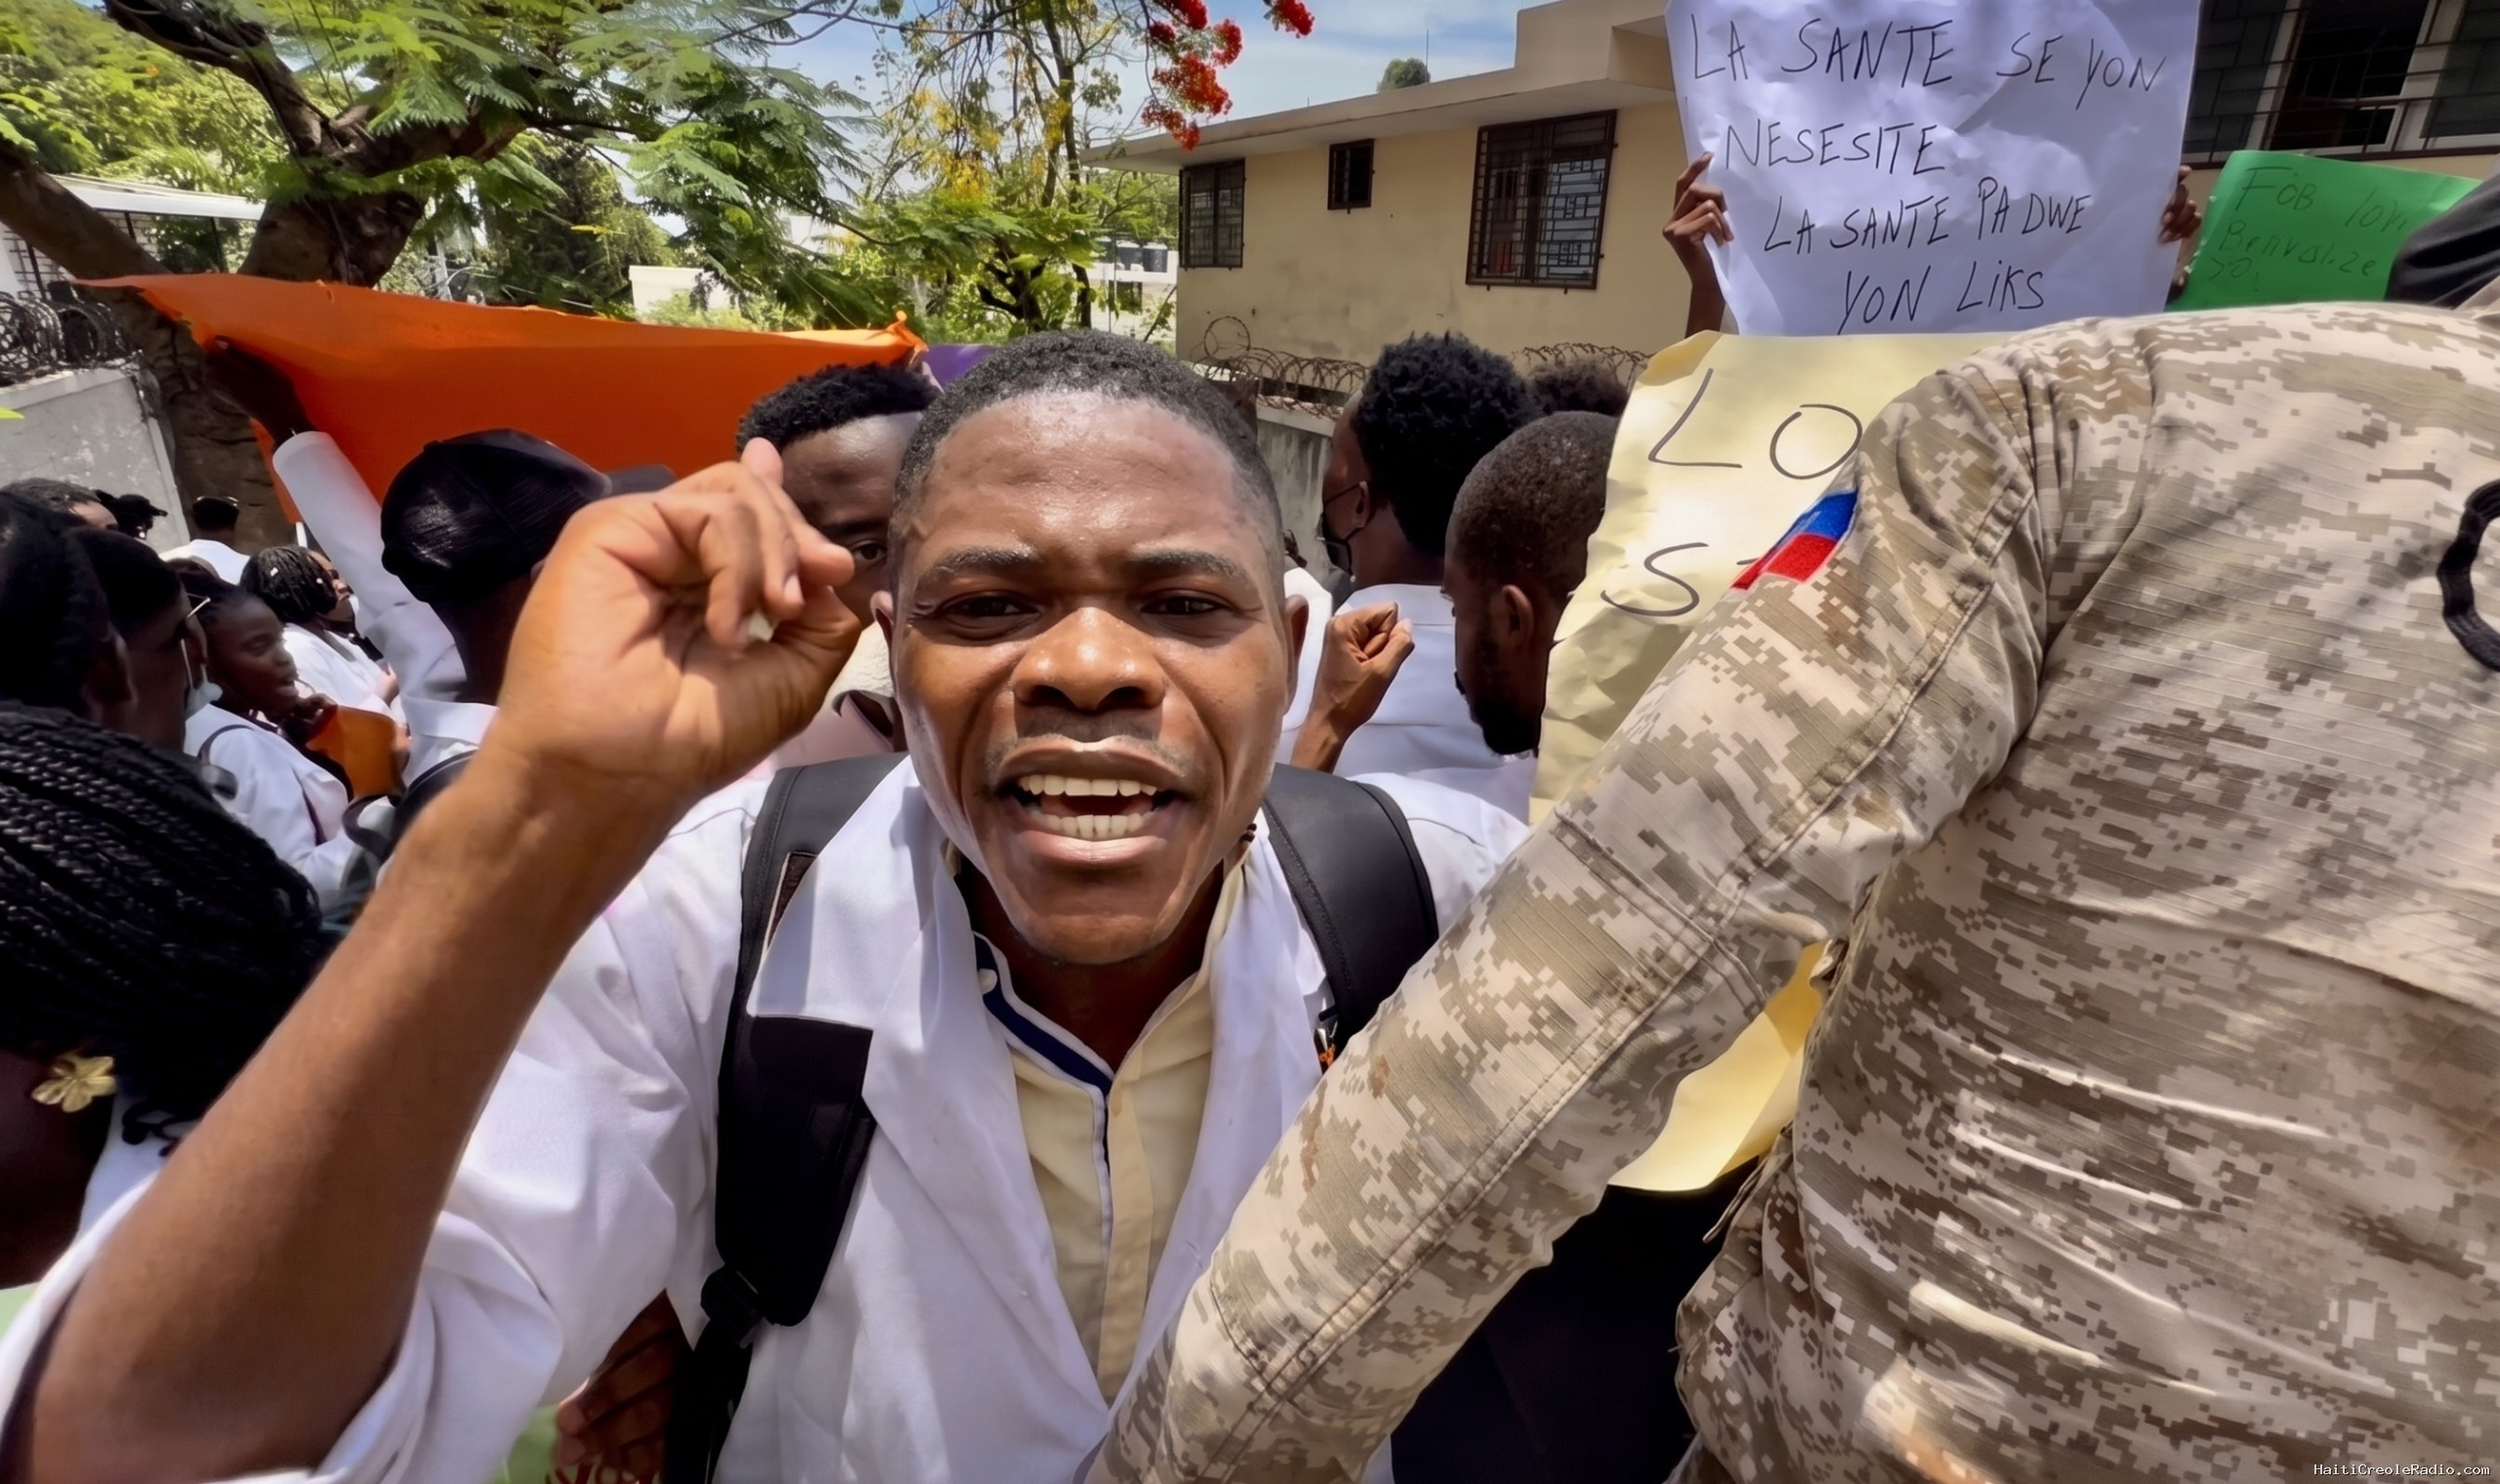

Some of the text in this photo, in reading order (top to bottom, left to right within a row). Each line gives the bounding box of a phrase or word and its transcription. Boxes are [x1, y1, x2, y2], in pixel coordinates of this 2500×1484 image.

[1690, 14, 2166, 110] LA SANTE SE YON
[1726, 118, 1945, 176] NESESITE
[1764, 176, 2092, 254] LA SANTE PA DWE
[1837, 265, 1932, 336] YON
